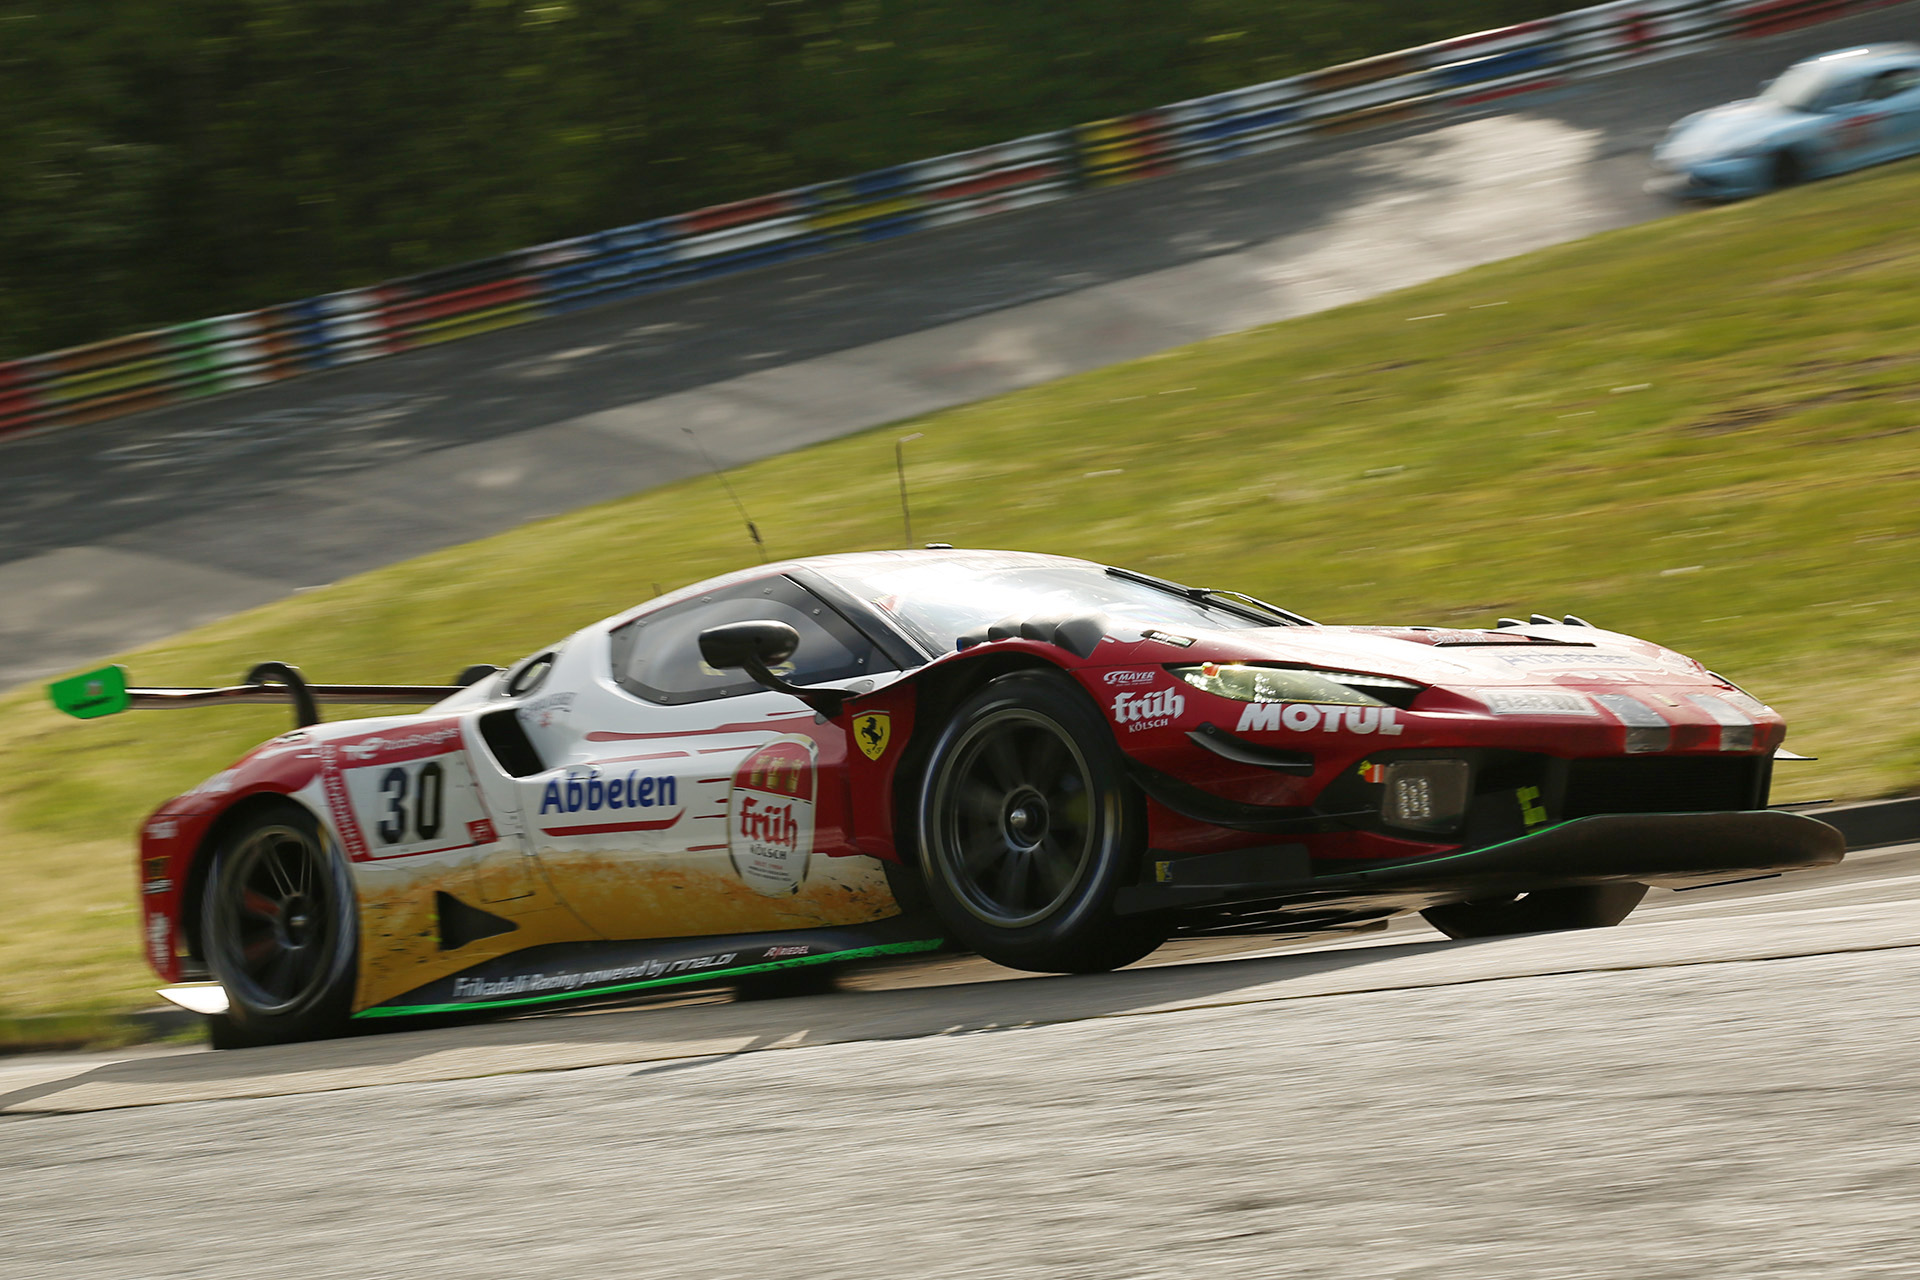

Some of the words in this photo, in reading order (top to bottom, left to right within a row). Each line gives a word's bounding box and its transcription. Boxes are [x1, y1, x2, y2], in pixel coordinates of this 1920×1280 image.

[1118, 671, 1155, 680] MAYER
[1128, 718, 1169, 733] KÖLSCH
[1235, 702, 1405, 736] MOTUL
[378, 761, 444, 845] 30
[538, 768, 678, 815] Abbelen
[750, 844, 787, 860] KÖLSCH
[453, 974, 529, 997] Frikadelli
[528, 971, 581, 990] Racing
[578, 960, 649, 988] powered
[648, 958, 671, 978] by
